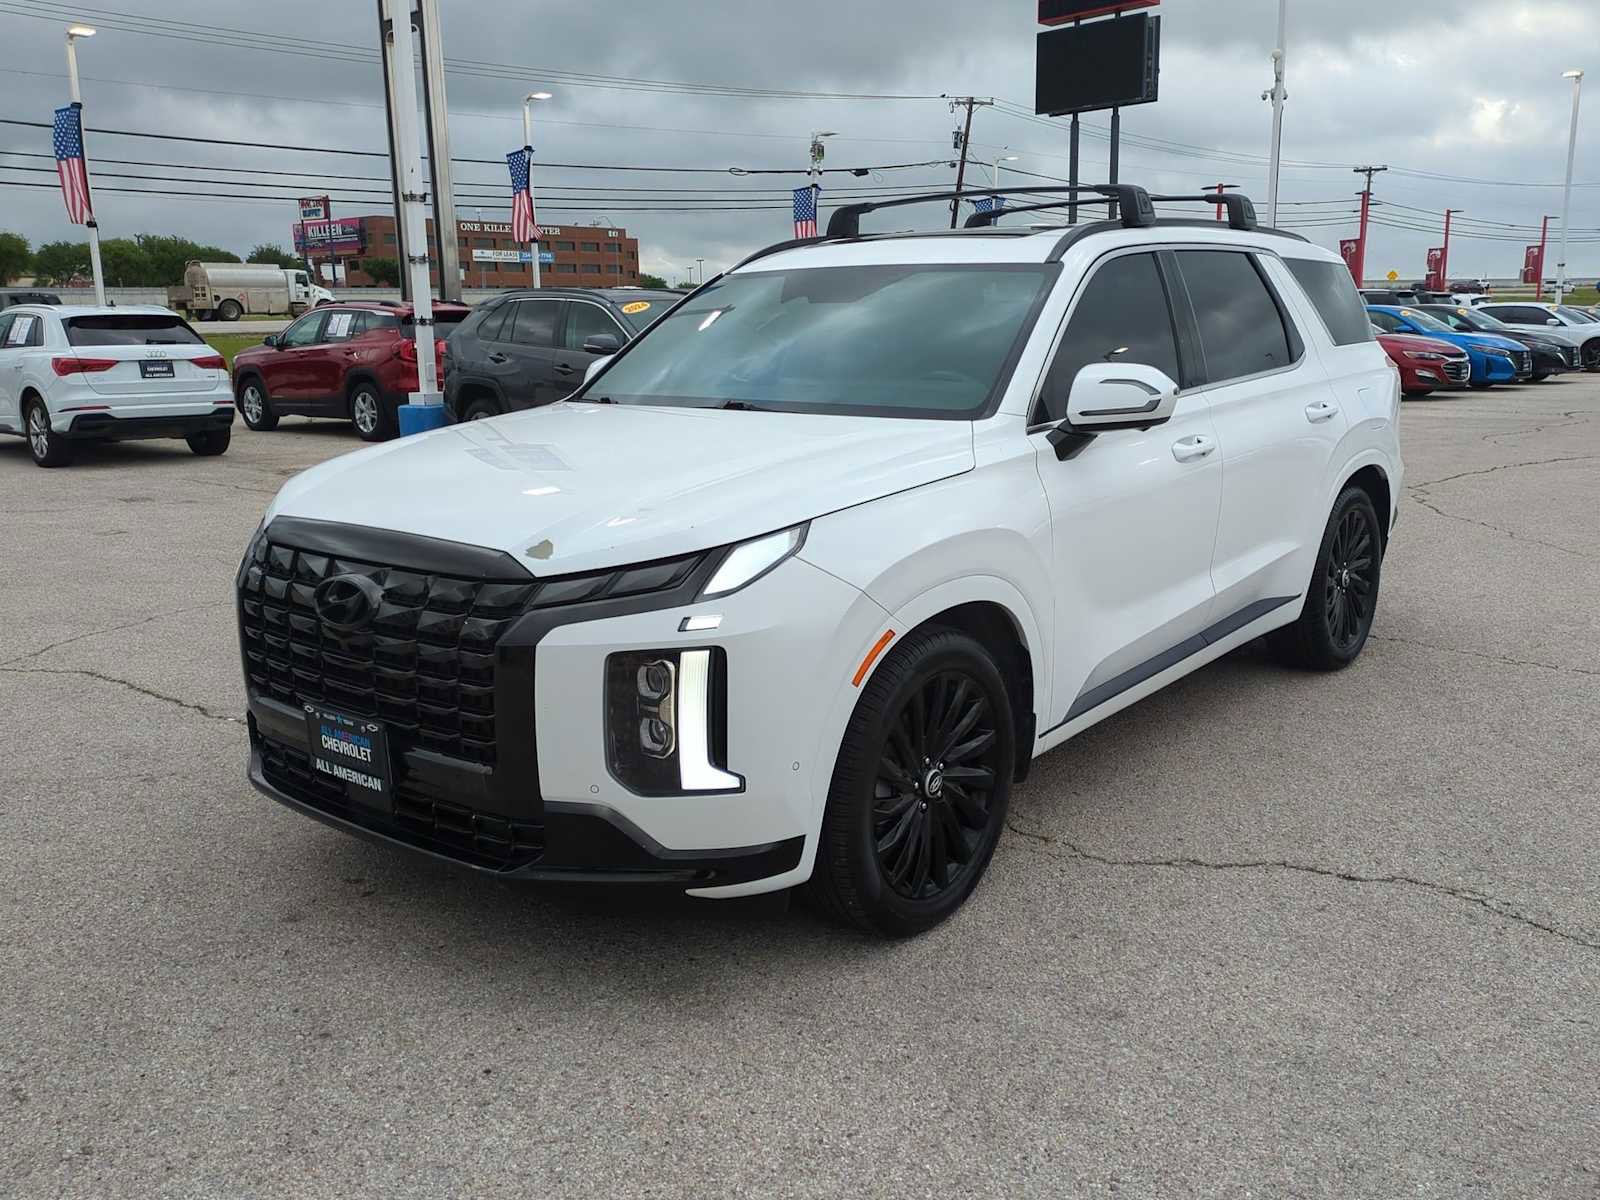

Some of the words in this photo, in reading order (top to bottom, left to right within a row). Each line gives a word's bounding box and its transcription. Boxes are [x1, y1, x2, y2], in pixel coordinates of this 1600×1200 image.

[460, 222, 480, 232] ONE
[483, 224, 512, 232] KILLE
[321, 734, 372, 763] CHEVROLET
[316, 758, 333, 774] ALL
[333, 764, 382, 792] AMERICAN
